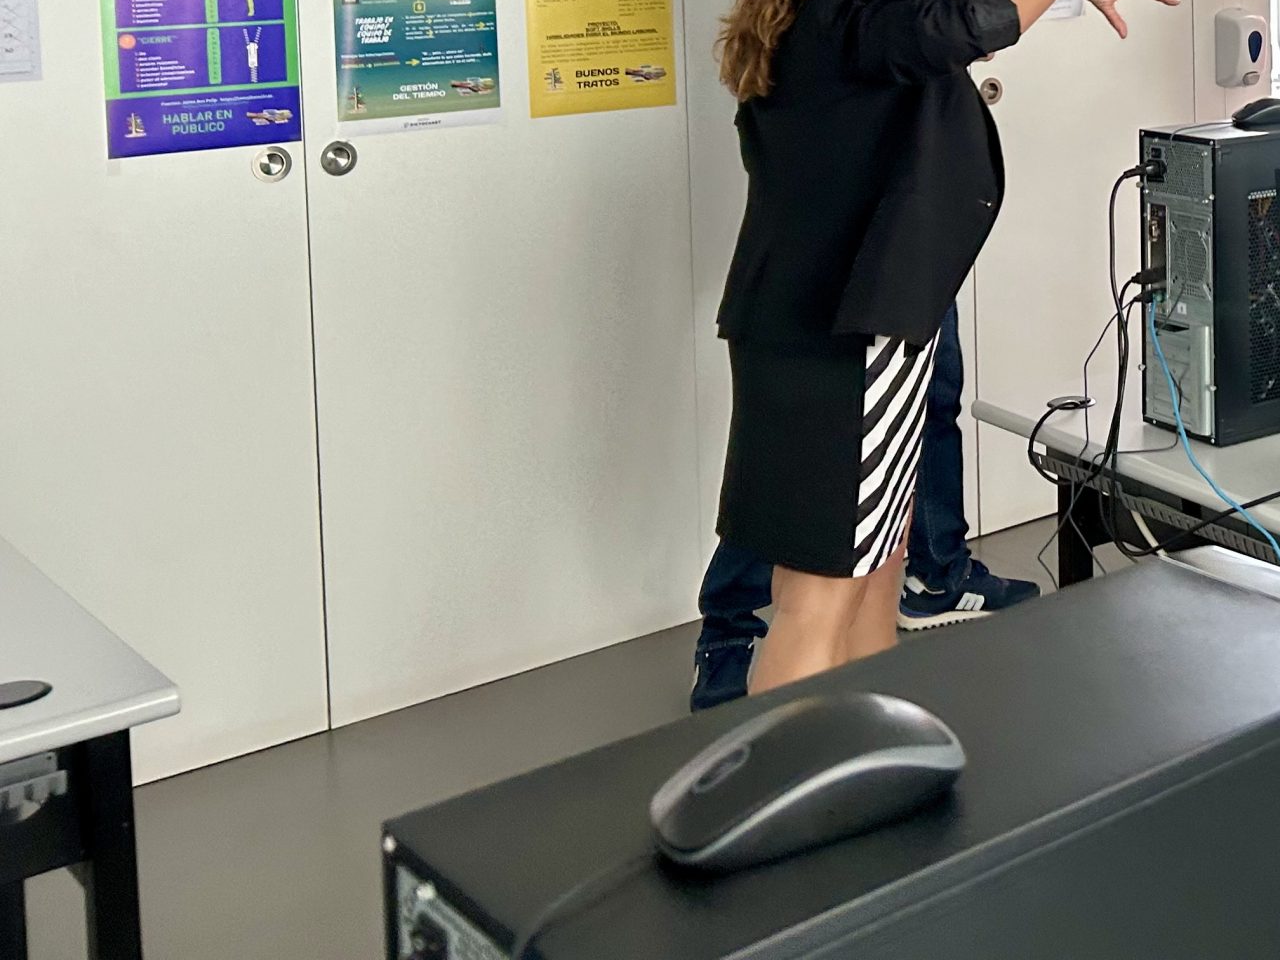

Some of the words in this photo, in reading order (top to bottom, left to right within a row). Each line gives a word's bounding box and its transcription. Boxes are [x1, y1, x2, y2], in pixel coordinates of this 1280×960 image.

[575, 67, 620, 78] BUENOS
[400, 82, 438, 92] GESTIÓN
[576, 78, 620, 89] TRATOS
[412, 90, 446, 99] TIEMPO
[162, 110, 212, 124] HABLAR
[216, 109, 232, 120] EN
